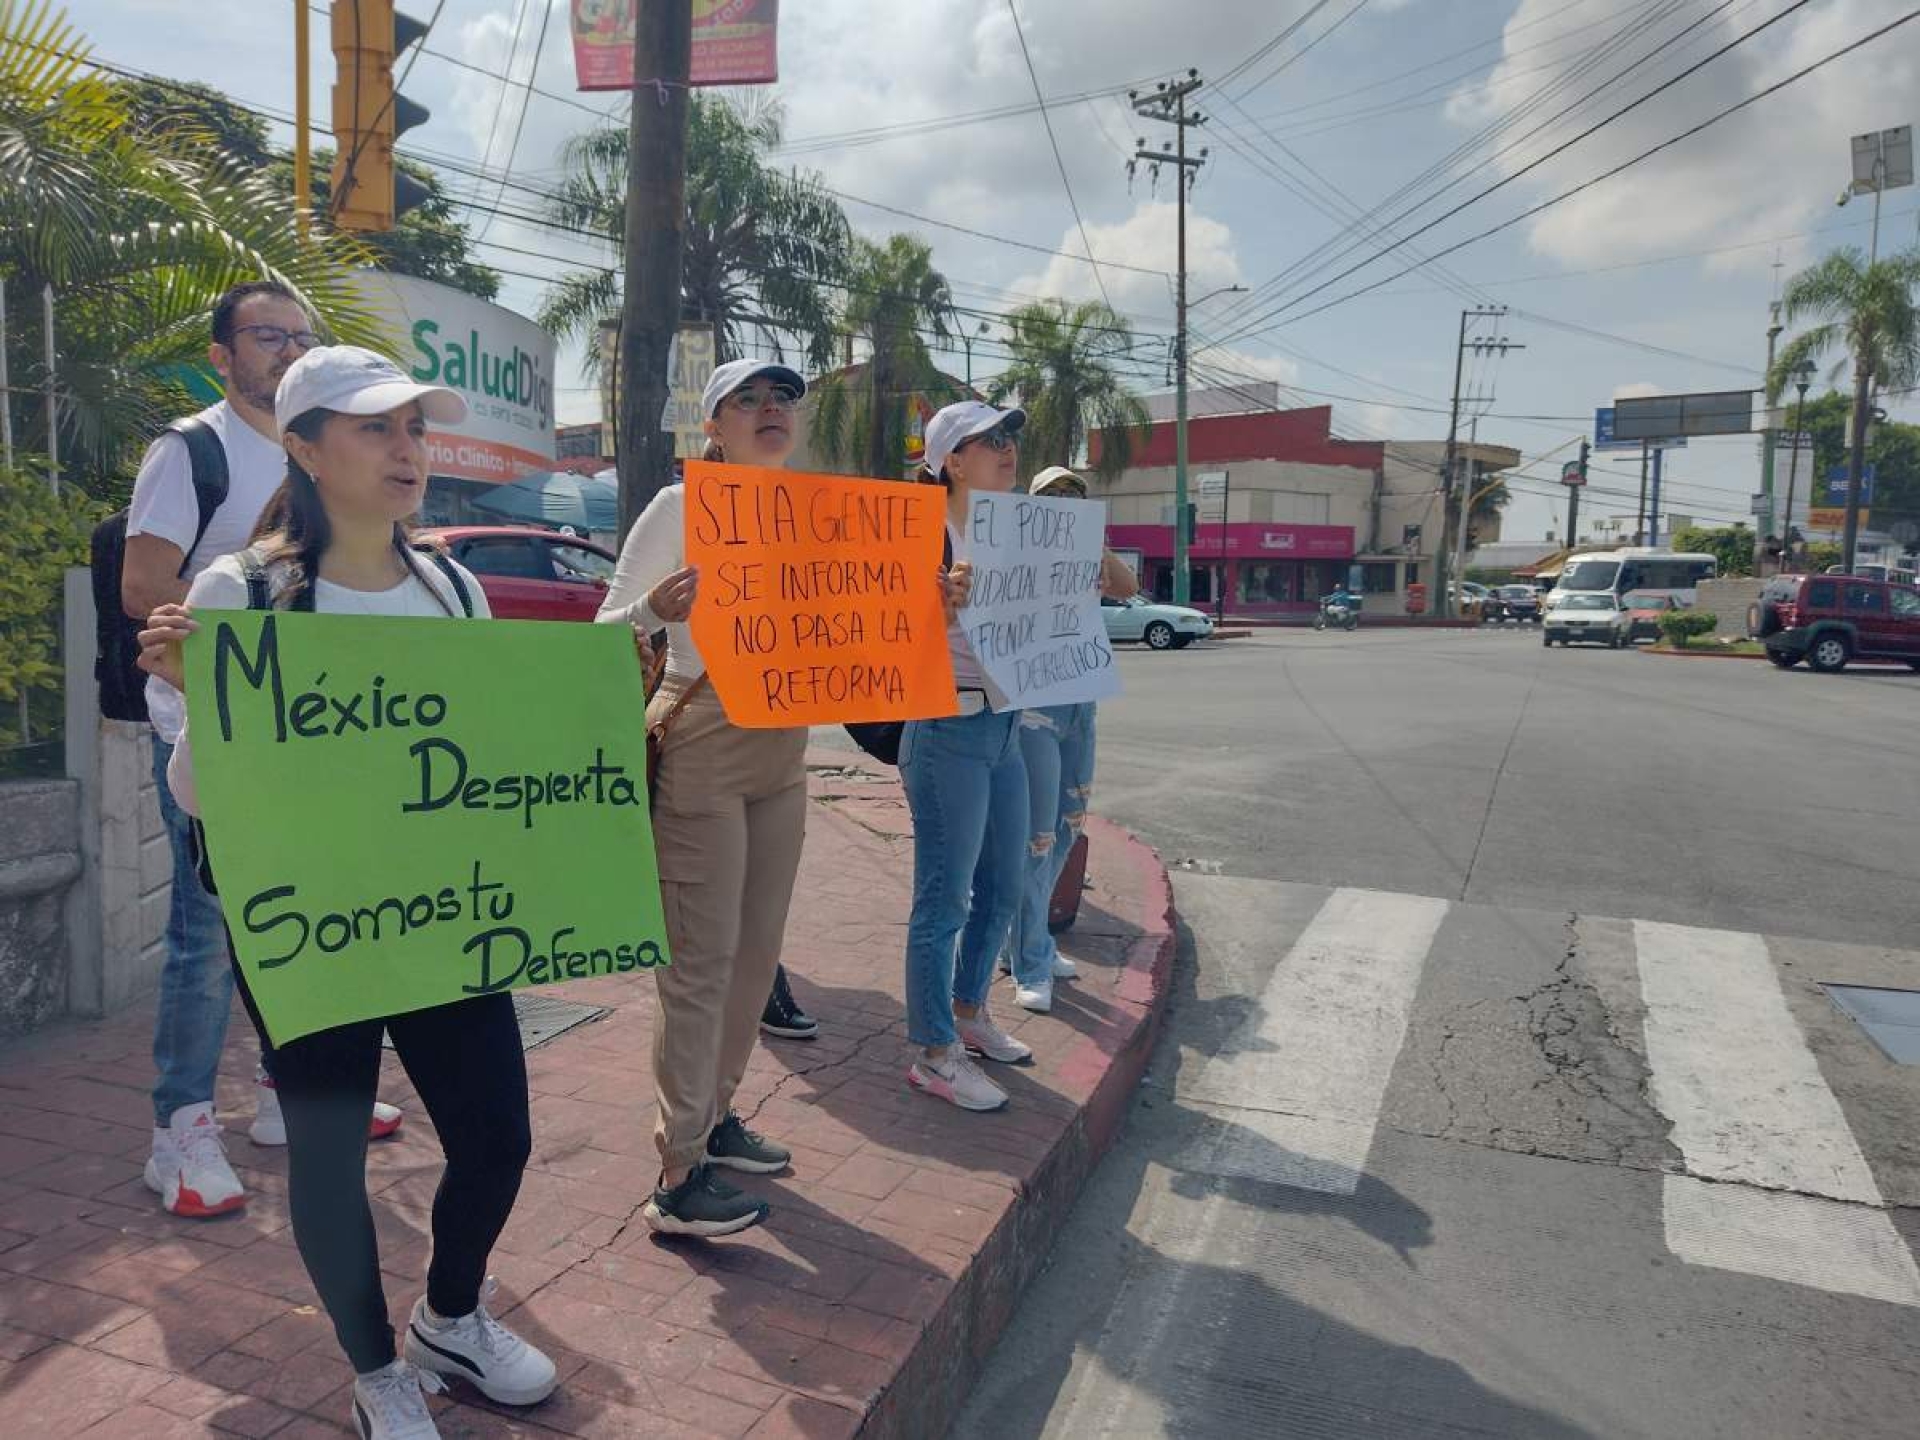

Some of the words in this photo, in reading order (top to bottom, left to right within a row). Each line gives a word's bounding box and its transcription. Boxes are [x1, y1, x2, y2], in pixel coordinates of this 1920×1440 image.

[696, 476, 748, 545] SI
[809, 487, 922, 544] GENTE
[974, 498, 999, 548] EL
[1015, 501, 1076, 550] PODER
[715, 561, 764, 607] SE
[781, 560, 908, 602] INFORMA
[735, 613, 777, 656] NO
[792, 610, 867, 649] PASA
[880, 610, 913, 643] LA
[215, 615, 447, 743] México
[763, 665, 905, 712] REFORMA
[403, 737, 639, 829] Despierta
[243, 885, 462, 971] Somos
[462, 926, 667, 994] Defensa
